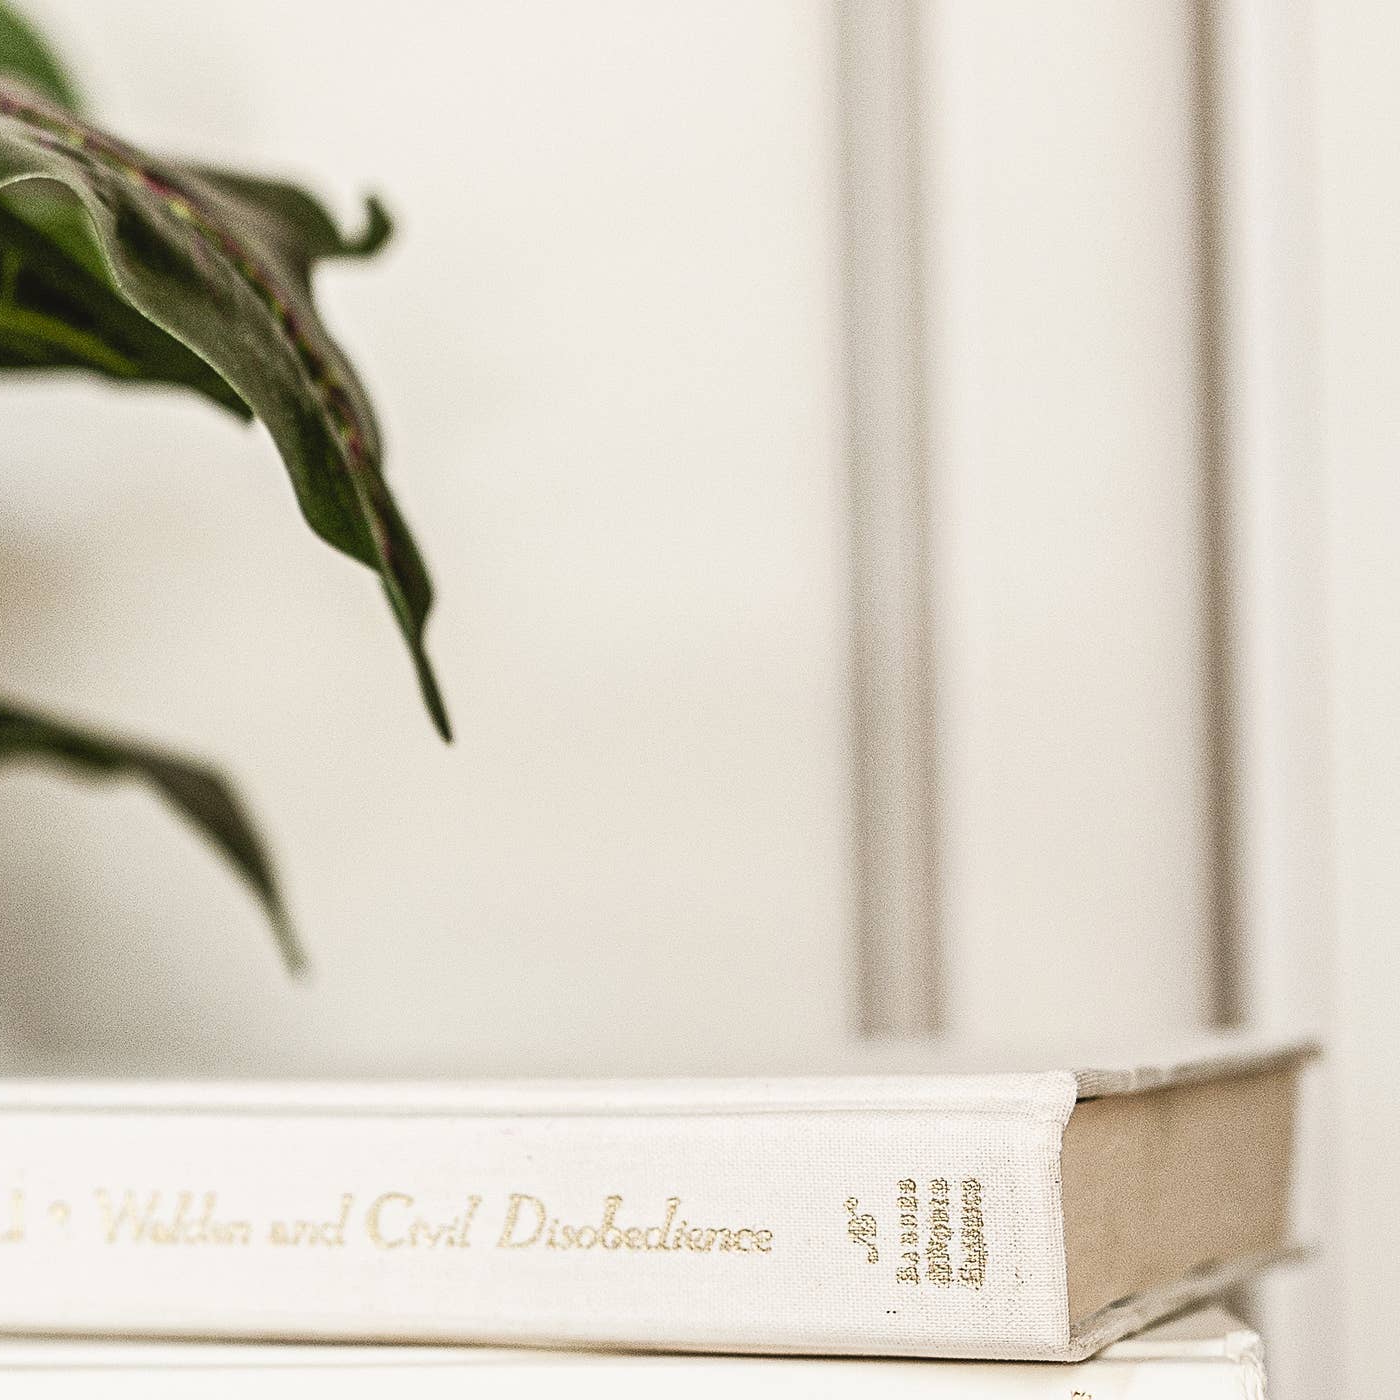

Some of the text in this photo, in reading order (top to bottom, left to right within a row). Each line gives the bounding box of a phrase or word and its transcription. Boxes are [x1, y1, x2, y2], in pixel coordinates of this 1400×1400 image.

[267, 1192, 357, 1248] and
[363, 1191, 484, 1251] Civil
[496, 1191, 777, 1256] Disobedience
